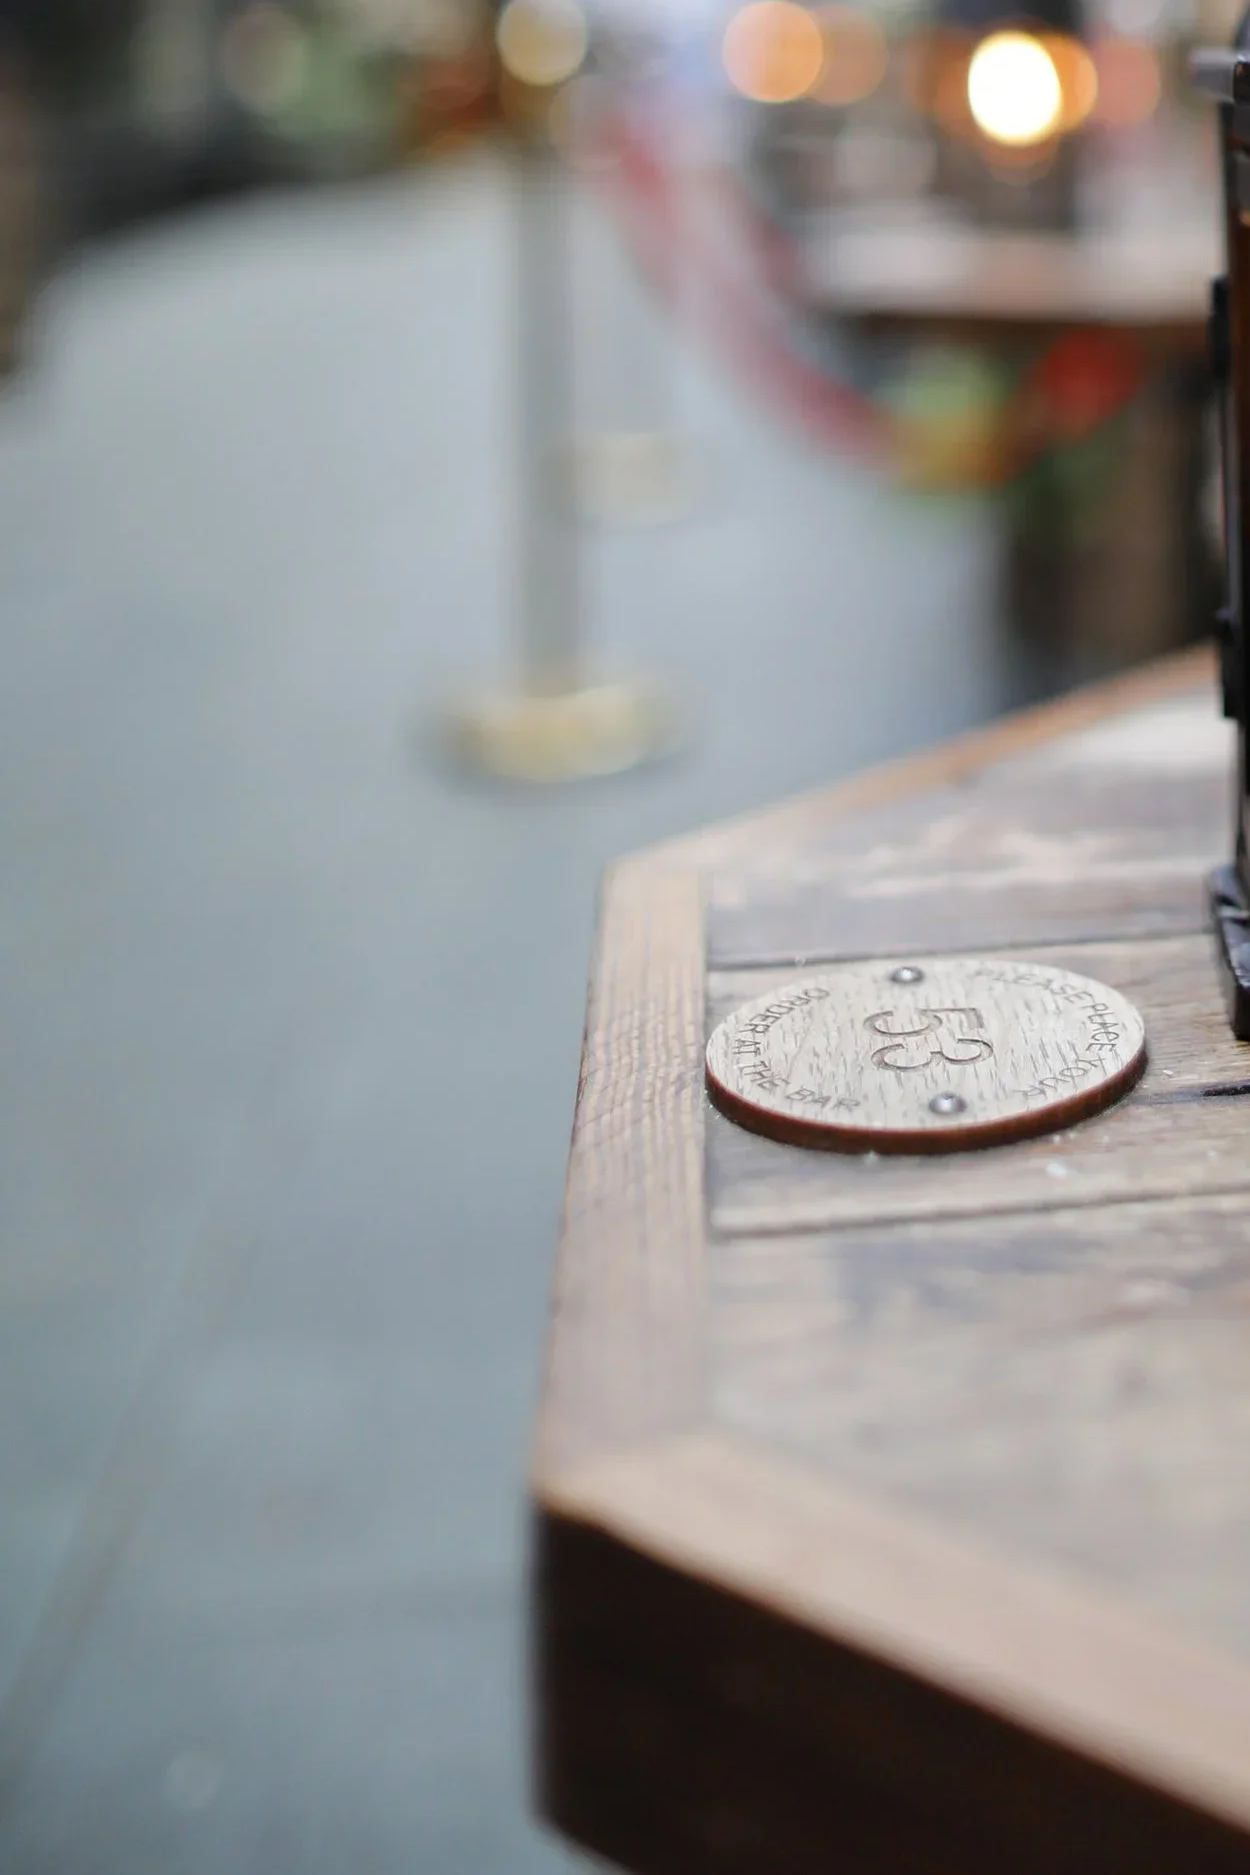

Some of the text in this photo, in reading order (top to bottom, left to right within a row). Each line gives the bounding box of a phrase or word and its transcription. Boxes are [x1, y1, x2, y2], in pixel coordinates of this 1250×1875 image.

[732, 987, 861, 1113] ORDER AT THE BAR
[863, 1007, 994, 1071] 53
[972, 968, 1121, 1100] PLEASE PLACE YOUR
